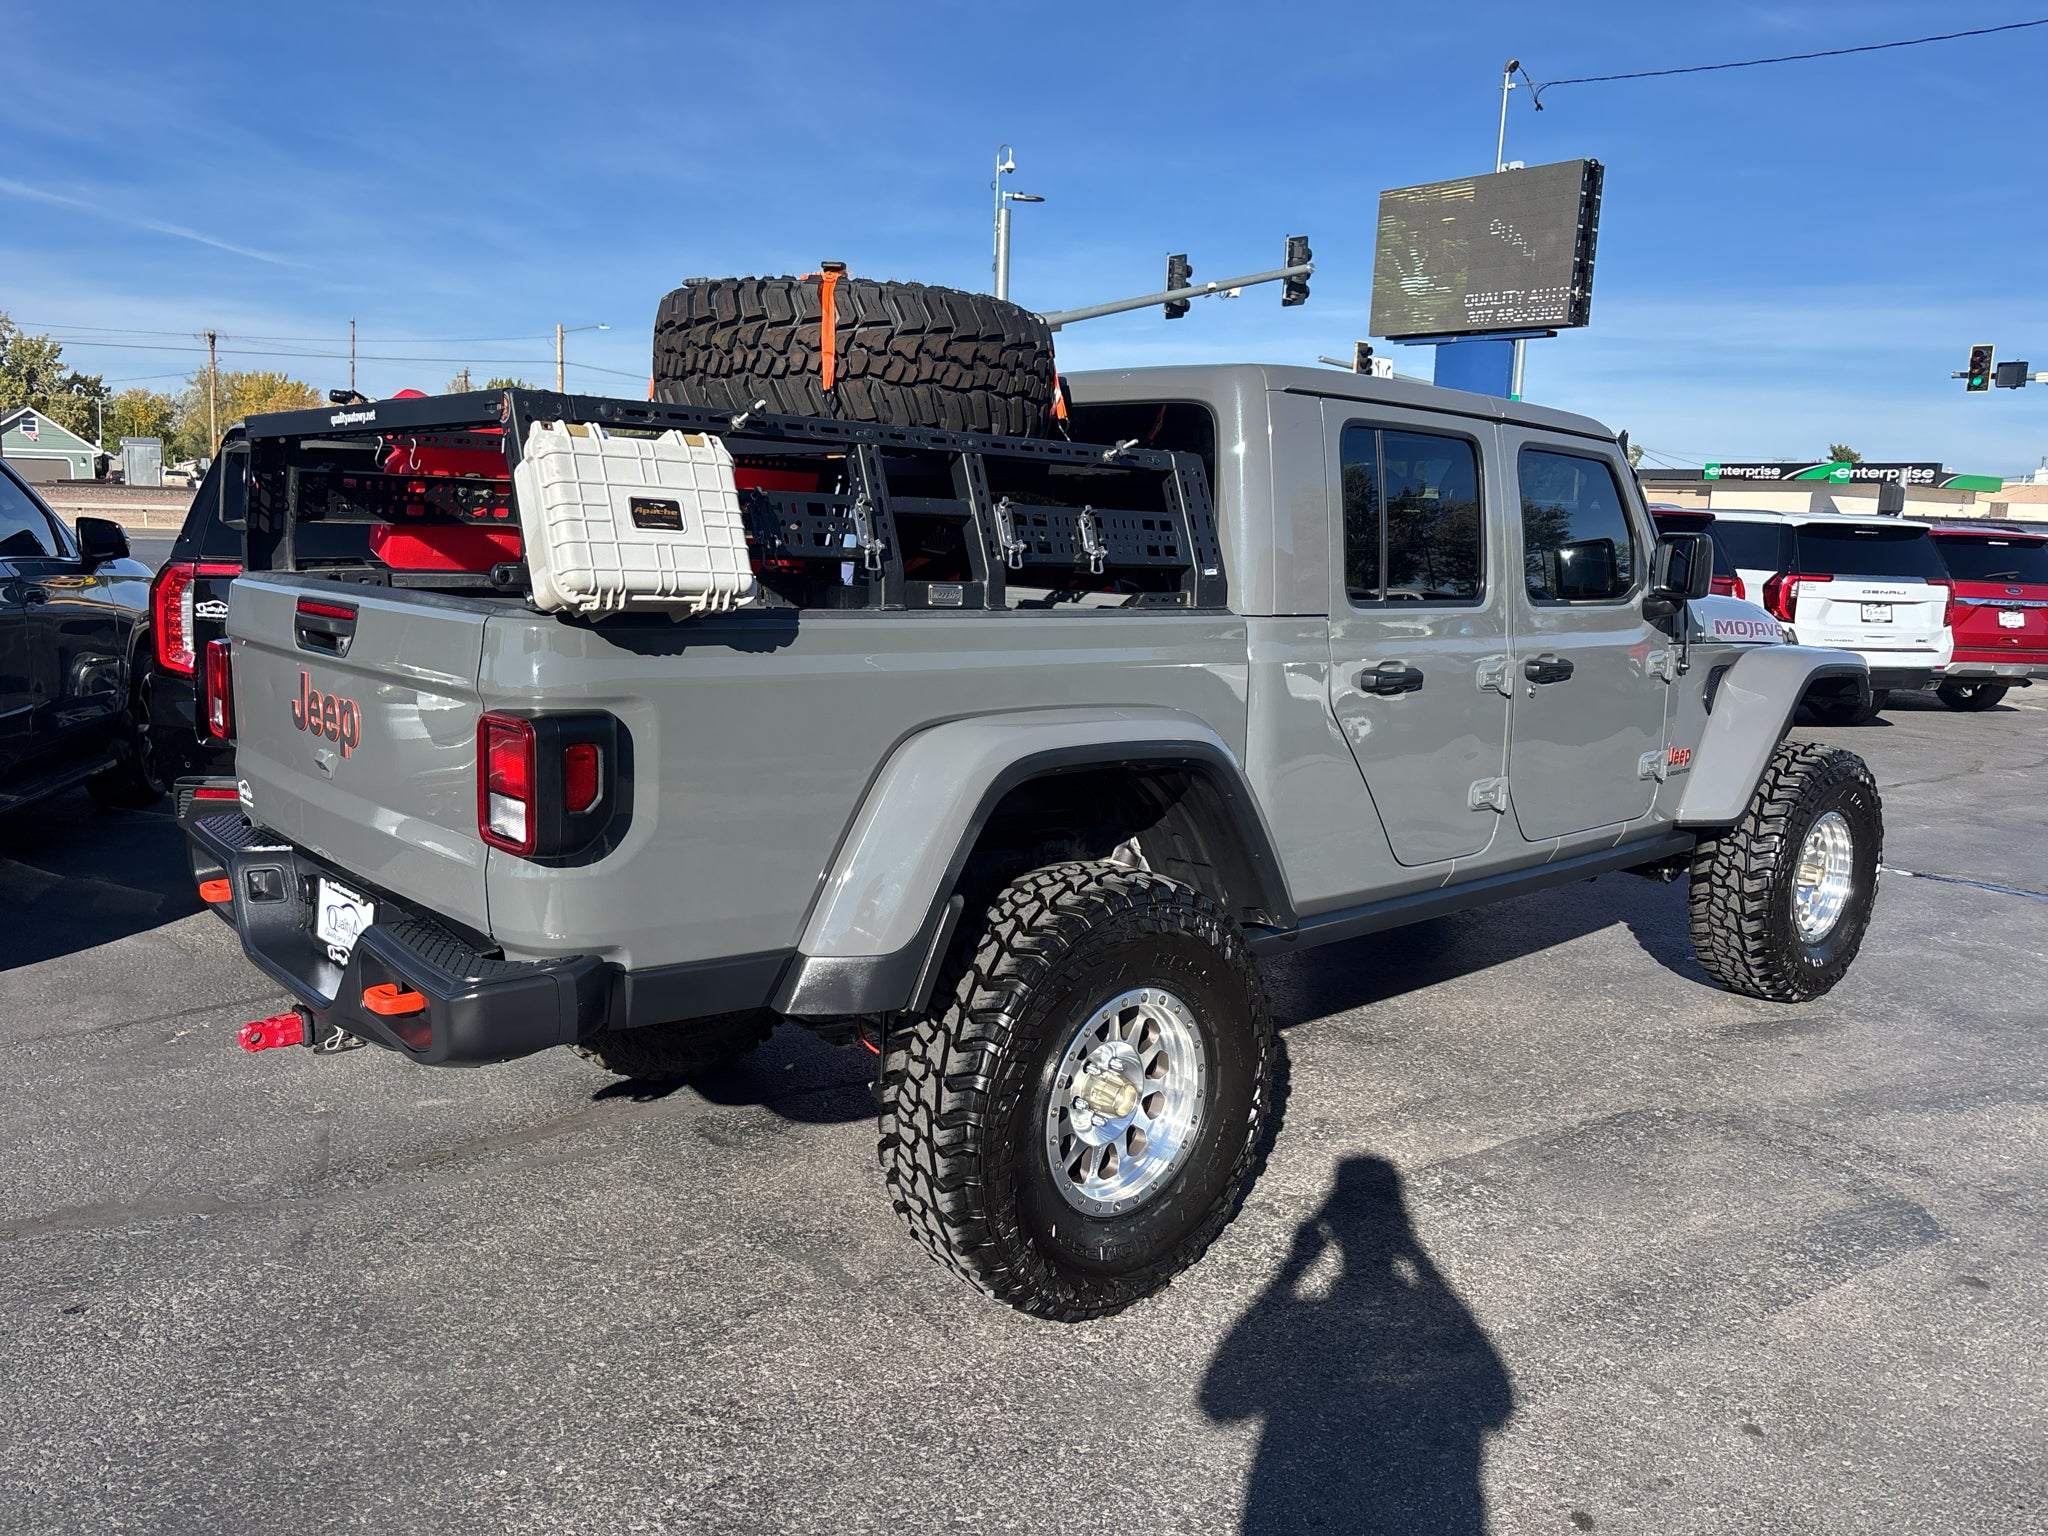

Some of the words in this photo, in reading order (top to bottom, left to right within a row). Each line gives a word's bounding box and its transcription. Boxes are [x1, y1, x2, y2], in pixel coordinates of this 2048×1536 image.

[1464, 290, 1526, 307] QUALITY
[1528, 286, 1570, 304] AUTO
[1705, 465, 1781, 478] enterprise
[1830, 465, 1936, 482] enterpise
[633, 505, 678, 516] Apache
[291, 671, 361, 760] Jeep
[1668, 746, 1691, 766] Jeep
